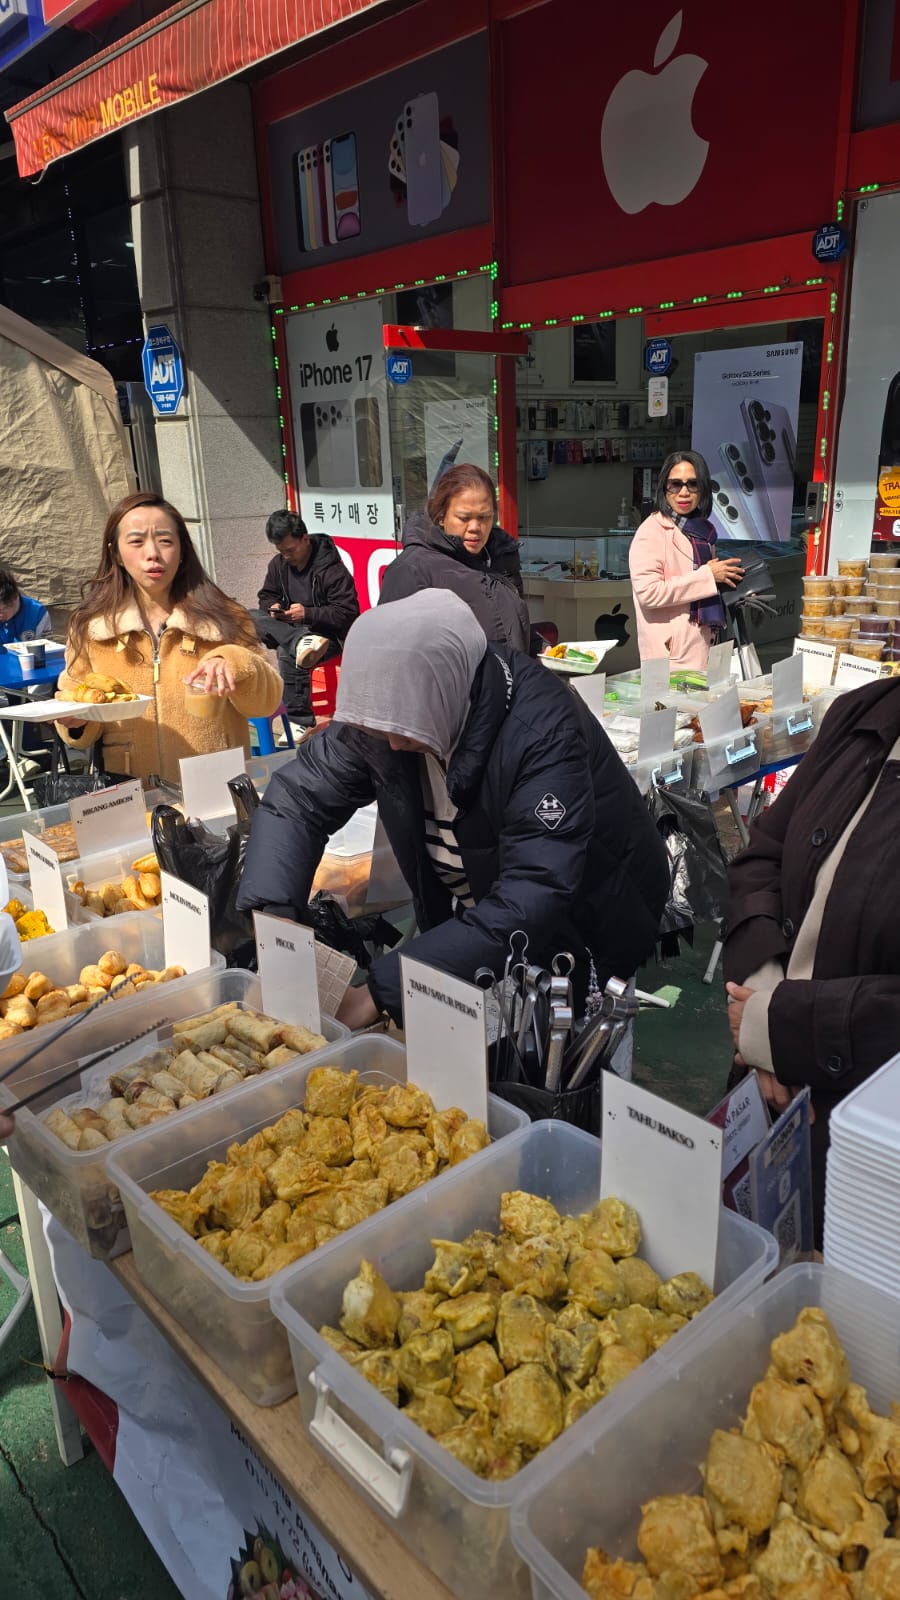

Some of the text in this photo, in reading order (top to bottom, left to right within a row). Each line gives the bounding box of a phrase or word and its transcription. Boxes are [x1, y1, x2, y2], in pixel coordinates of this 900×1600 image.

[100, 72, 161, 129] MOBILE
[816, 234, 840, 251] ADT
[650, 349, 668, 363] ADT
[766, 347, 799, 358] SAMSUNG
[152, 354, 175, 385] ADT
[300, 354, 373, 388] iPhone 17
[391, 361, 408, 374] ADT
[314, 501, 379, 525] 특가매장
[409, 978, 431, 996] TAHU
[431, 988, 455, 1008] SAYUR
[731, 1096, 752, 1121] PASAR
[626, 1105, 658, 1130] TAHU
[657, 1122, 696, 1150] BAKSO
